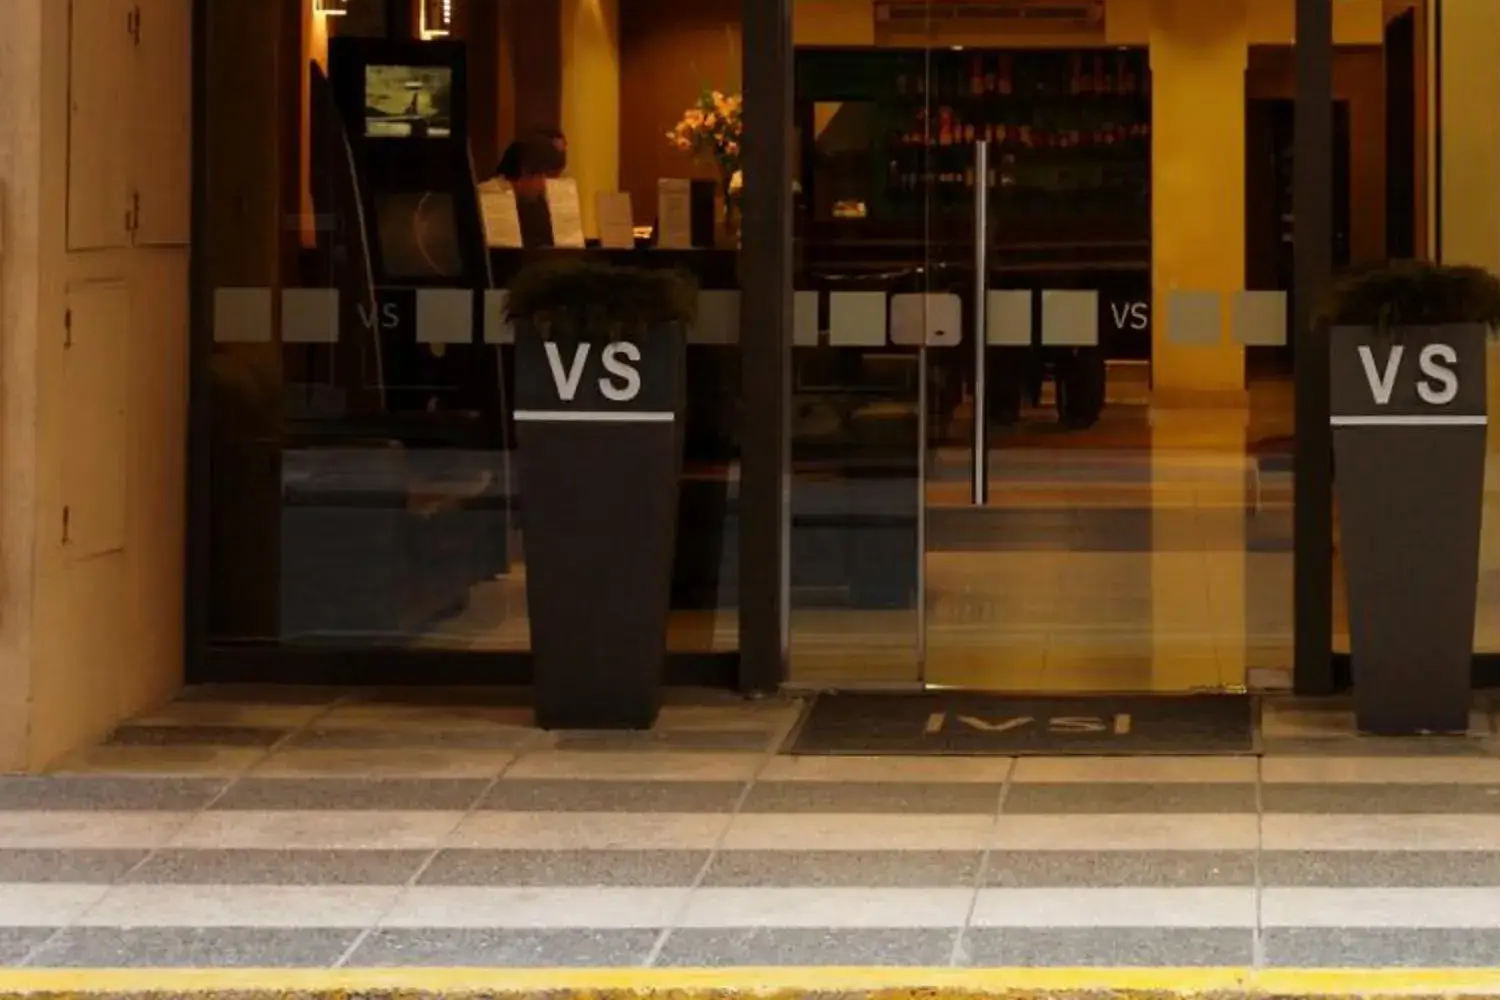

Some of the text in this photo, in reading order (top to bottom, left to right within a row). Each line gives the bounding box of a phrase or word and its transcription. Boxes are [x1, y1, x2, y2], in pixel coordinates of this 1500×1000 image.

[1111, 300, 1149, 331] VS
[543, 340, 641, 402] VS
[1356, 343, 1459, 405] VS
